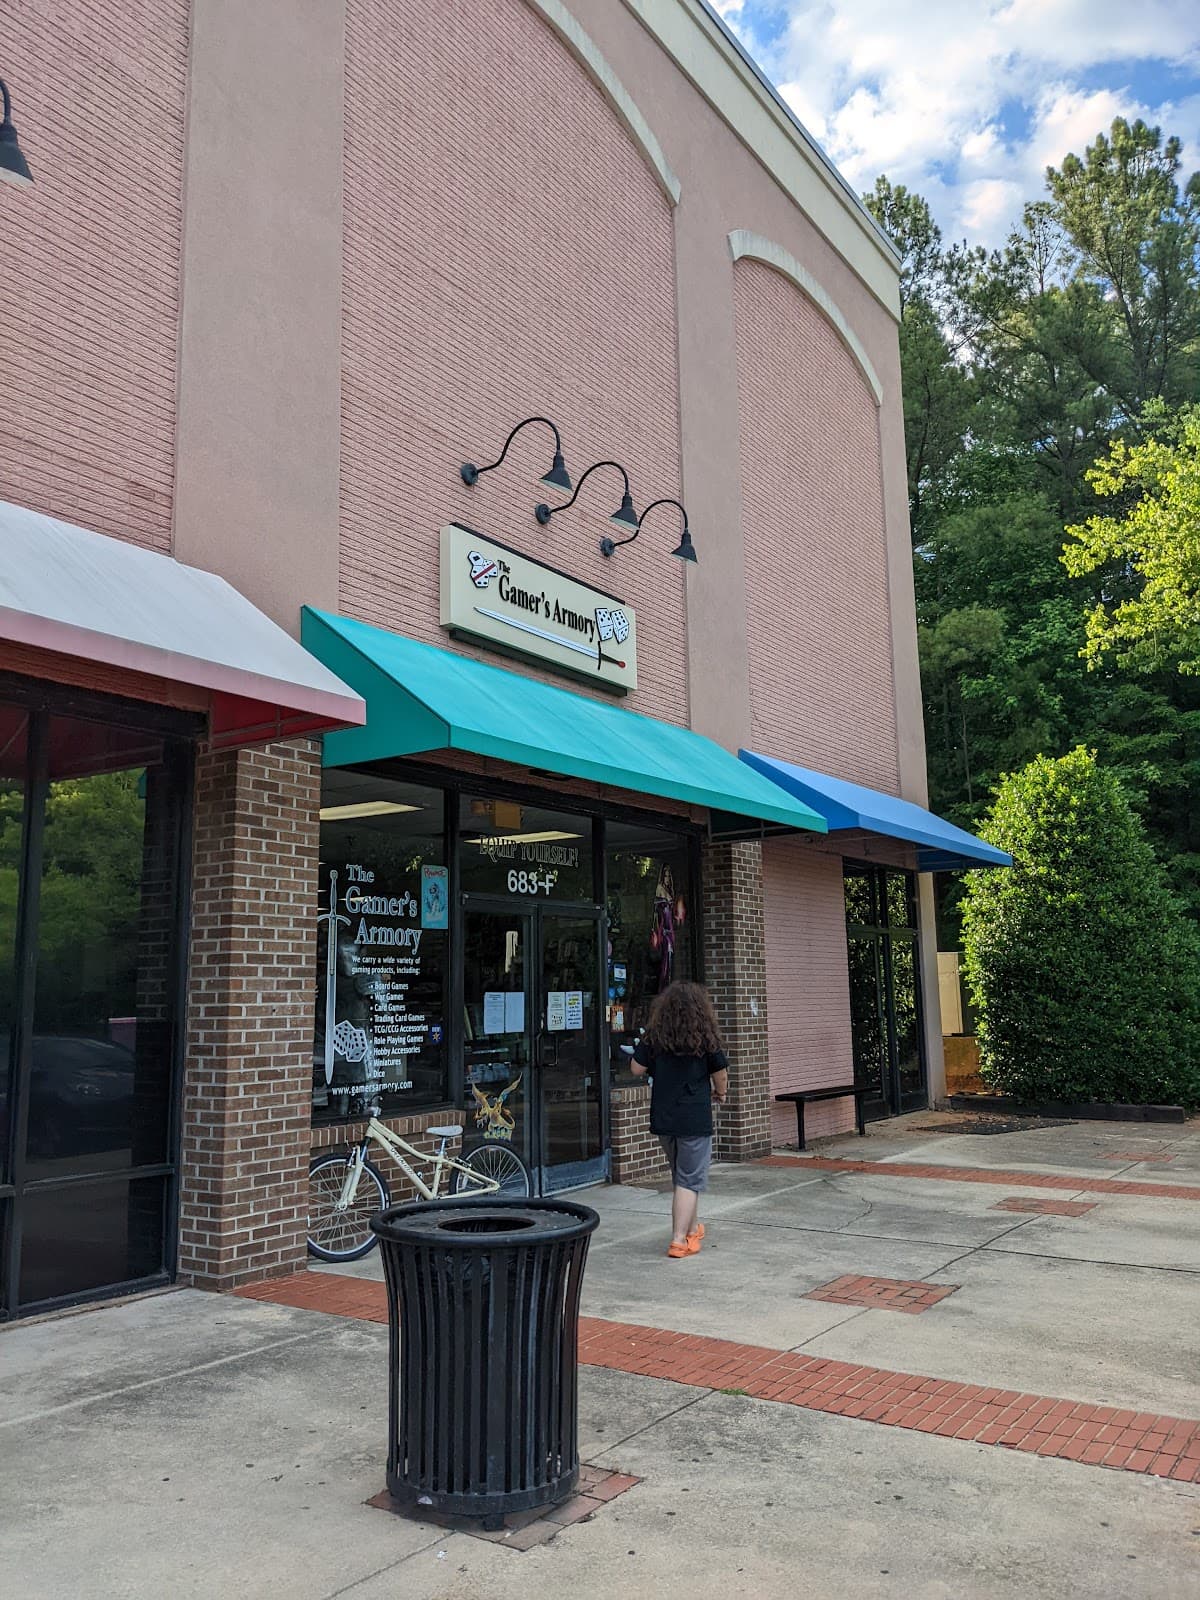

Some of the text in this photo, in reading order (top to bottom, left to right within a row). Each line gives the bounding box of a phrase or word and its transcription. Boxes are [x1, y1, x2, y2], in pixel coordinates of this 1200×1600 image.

[498, 560, 511, 574] The
[499, 575, 596, 642] Gamer's Armory
[479, 834, 580, 868] EQUIP YOURSELF!
[345, 863, 375, 883] The
[507, 869, 555, 896] 683-F
[345, 885, 418, 918] Gamer's
[353, 917, 423, 955] Armory
[351, 955, 361, 963] We
[362, 956, 377, 965] carry
[382, 956, 396, 964] wide
[396, 957, 414, 965] variety
[351, 967, 371, 975] gaming
[374, 981, 409, 990] Board Games
[374, 993, 404, 1001] War Games
[374, 1003, 406, 1012] Card Games
[374, 1013, 425, 1024] Trading Card Games
[374, 1025, 400, 1034] TCG/CCG
[400, 1024, 429, 1033] Accessories
[373, 1034, 424, 1045] Role Playing Games
[373, 1045, 421, 1056] Hobby Accessories
[373, 1058, 401, 1067] Miniatures
[373, 1070, 386, 1078] Dice
[331, 1081, 413, 1097] www.gamersarmory.com
